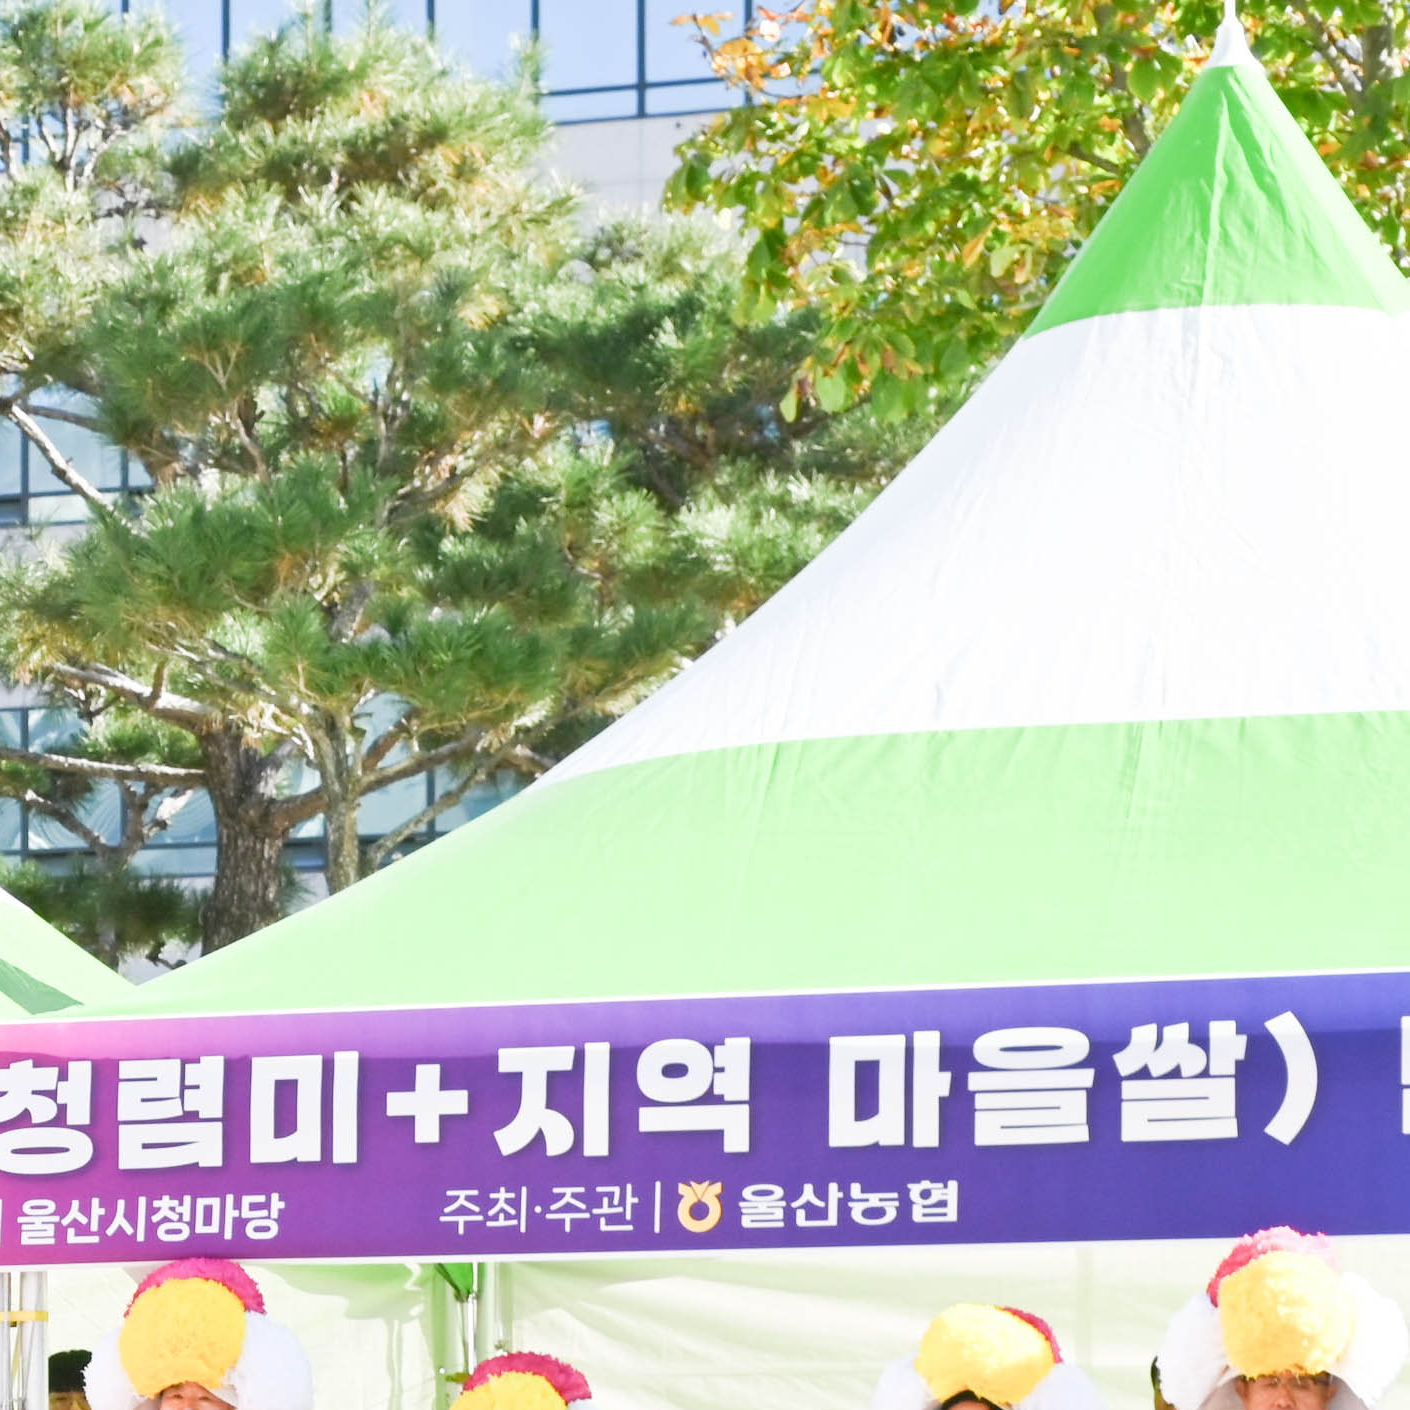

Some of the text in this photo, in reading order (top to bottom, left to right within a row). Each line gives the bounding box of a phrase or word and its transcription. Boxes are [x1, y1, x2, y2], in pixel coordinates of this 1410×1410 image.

[829, 1010, 1318, 1147] 마을쌀)
[17, 1192, 285, 1245] 울산시청마당
[739, 1180, 958, 1228] 울산농협
